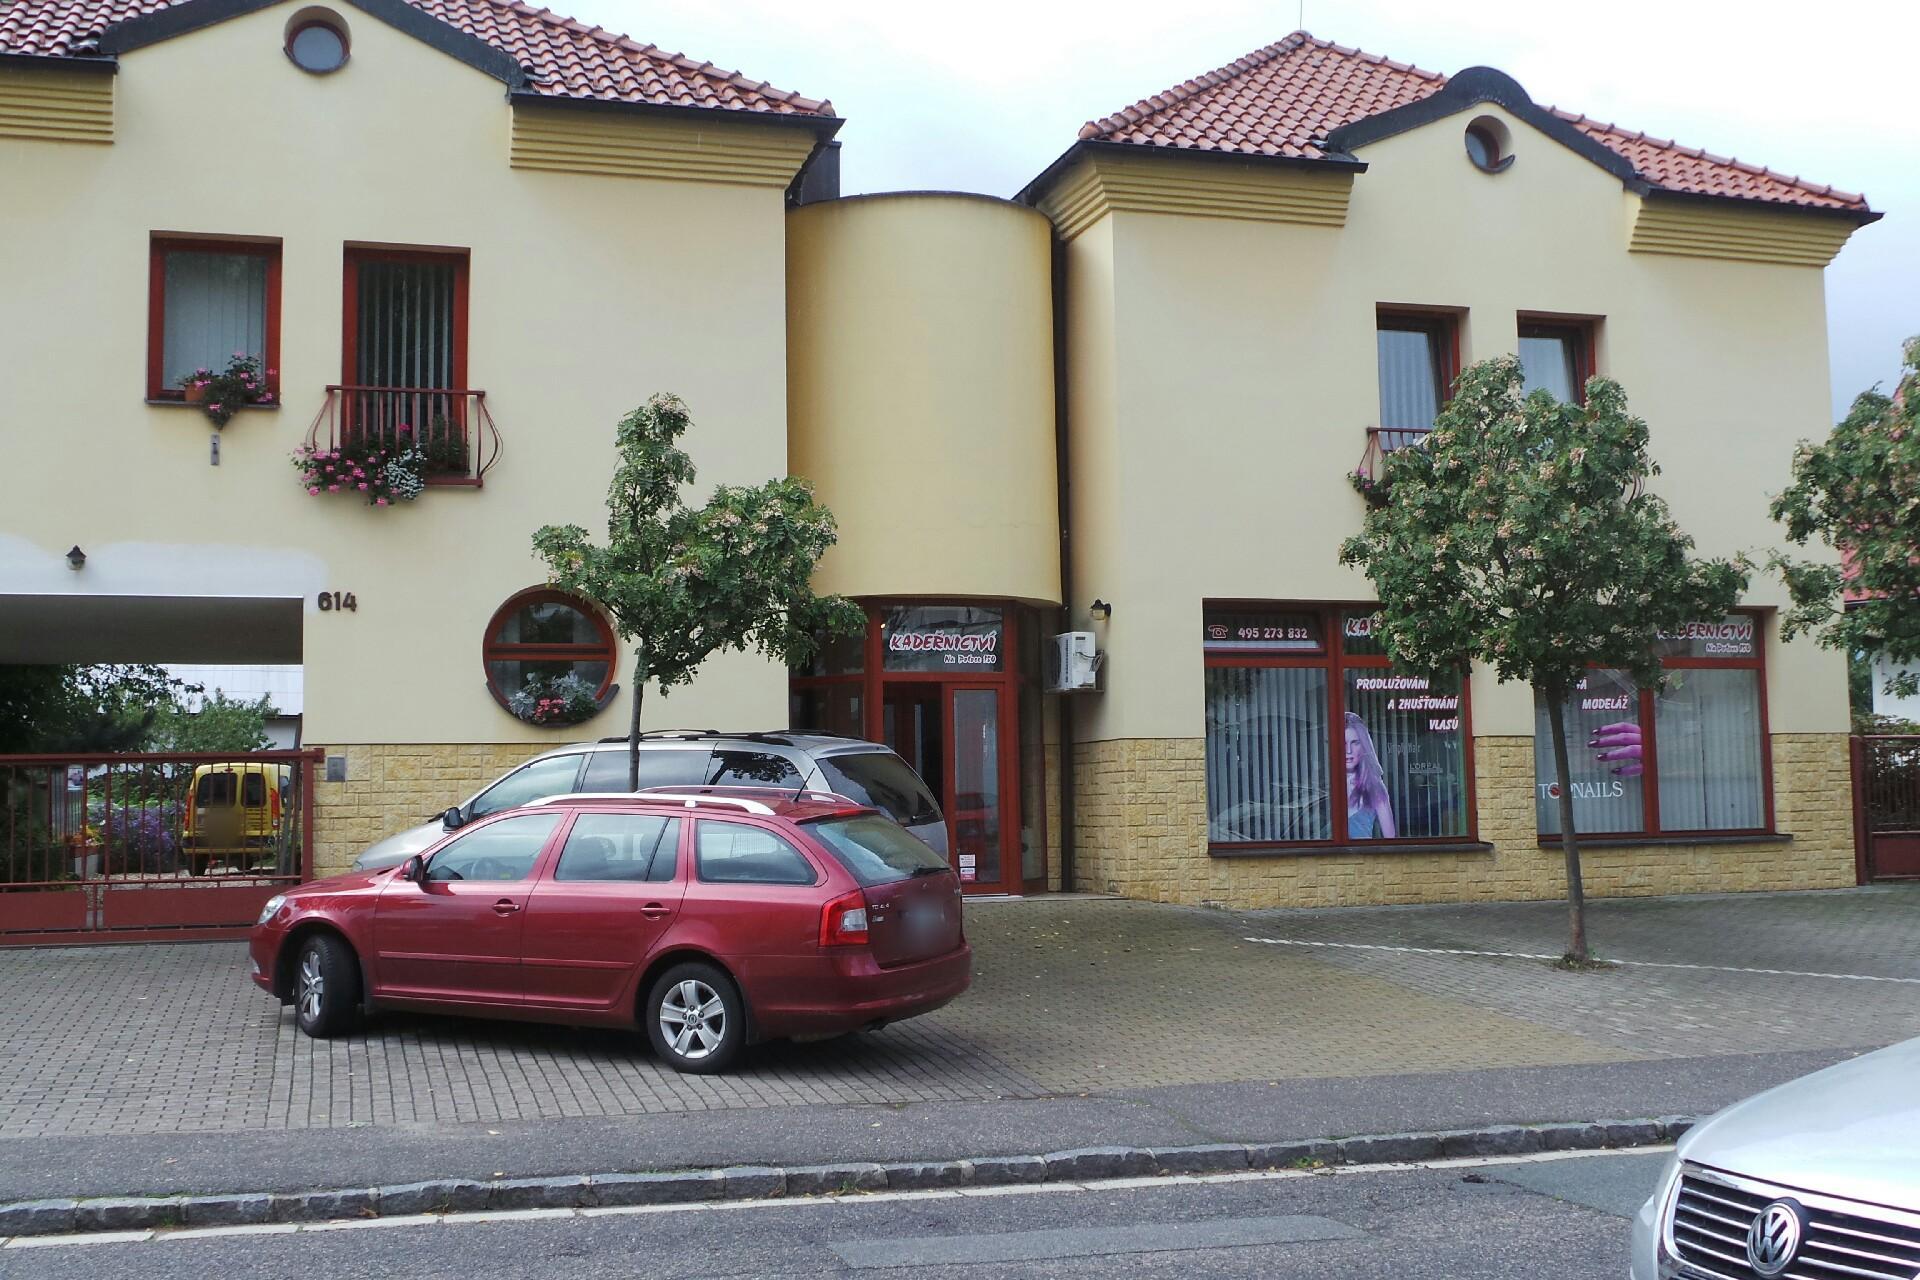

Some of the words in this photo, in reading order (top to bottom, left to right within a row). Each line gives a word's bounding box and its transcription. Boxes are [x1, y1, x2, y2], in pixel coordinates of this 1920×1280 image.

[318, 591, 357, 612] 614
[889, 630, 997, 652] KADEŘNICTVÍ
[1238, 628, 1259, 639] 495
[1264, 628, 1283, 639] 273
[1288, 628, 1308, 639] 832
[1387, 698, 1395, 710] A
[1398, 695, 1459, 710] ZHUŠŤOVÁNÍ
[1582, 694, 1629, 710] MODELÁŽ
[1538, 781, 1624, 799] TONAILS
